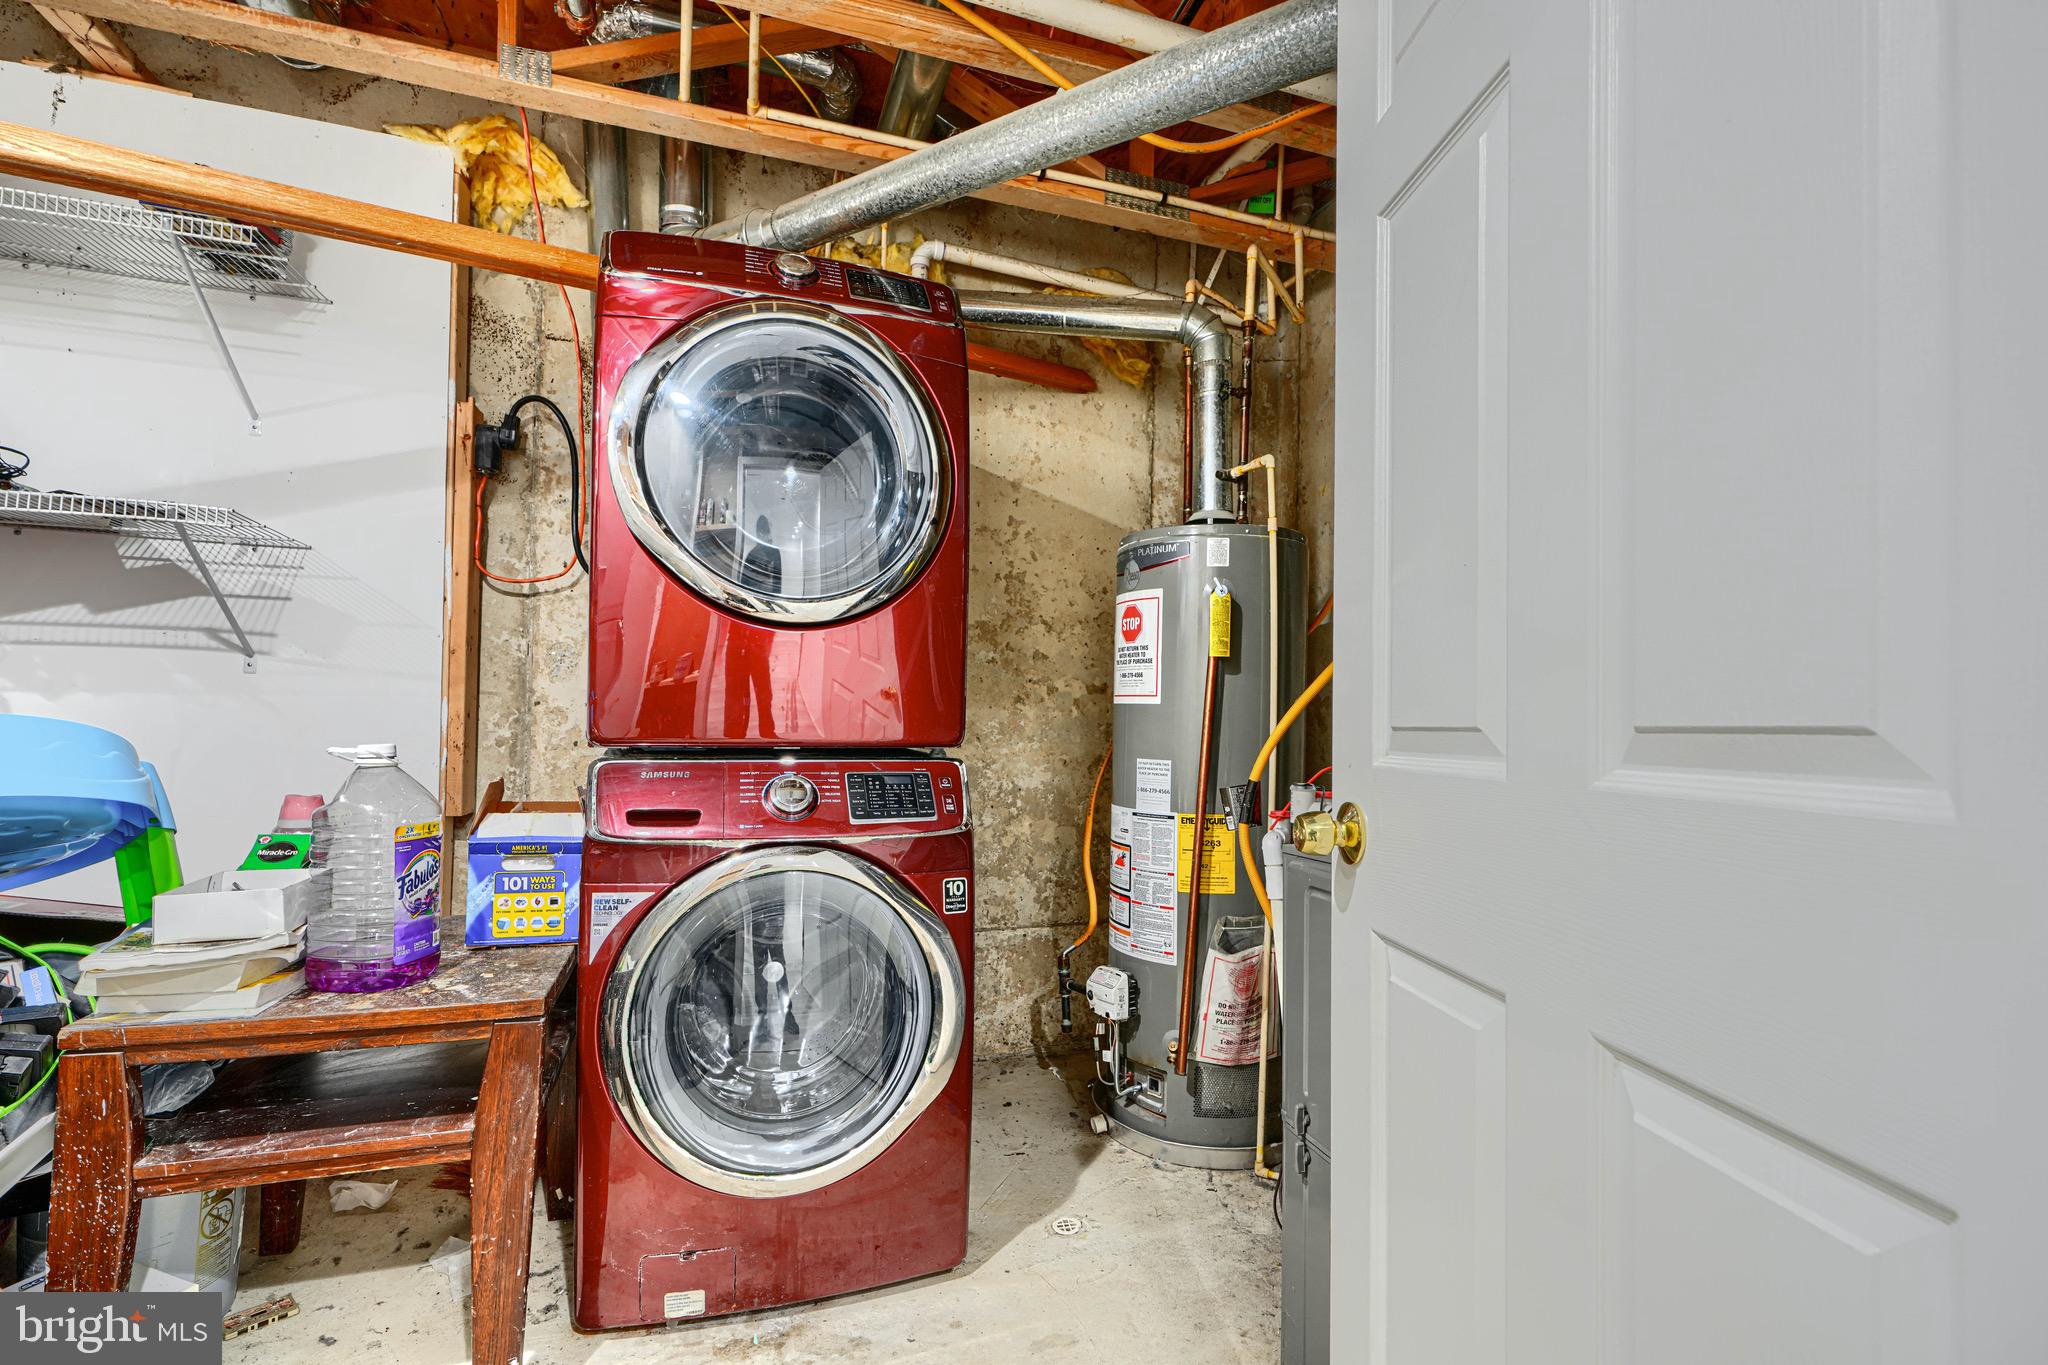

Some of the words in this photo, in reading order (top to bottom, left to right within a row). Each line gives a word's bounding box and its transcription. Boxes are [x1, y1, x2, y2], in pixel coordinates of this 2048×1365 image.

[1137, 543, 1177, 557] PLATINUM
[1122, 616, 1141, 632] STOP
[640, 771, 691, 779] SAMSUNG
[396, 857, 441, 901] Fabulos
[502, 876, 528, 891] 101
[530, 876, 556, 884] WAYS
[946, 881, 965, 896] 10
[1215, 1010, 1236, 1018] WATER
[1216, 1018, 1235, 1026] PLACE
